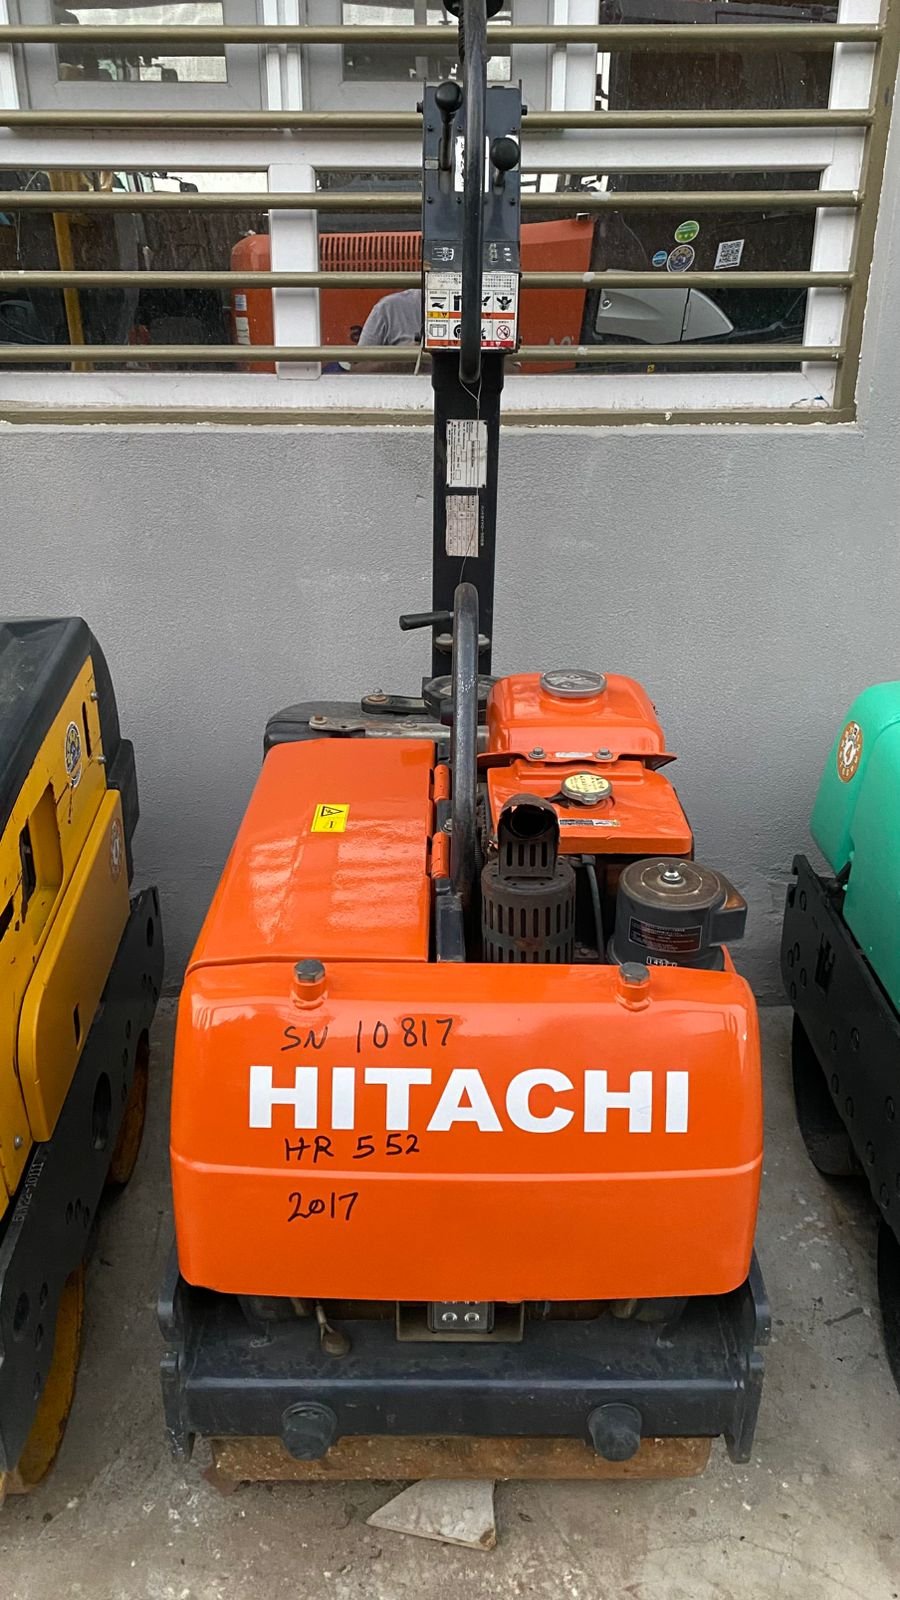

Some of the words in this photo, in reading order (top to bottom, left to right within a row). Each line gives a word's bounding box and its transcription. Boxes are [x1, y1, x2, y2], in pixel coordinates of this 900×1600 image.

[281, 1026, 328, 1051] SN
[356, 1018, 453, 1053] 10817
[248, 1065, 689, 1134] HITACHI
[285, 1135, 334, 1163] HR
[353, 1133, 420, 1159] 552
[287, 1191, 359, 1223] 2017
